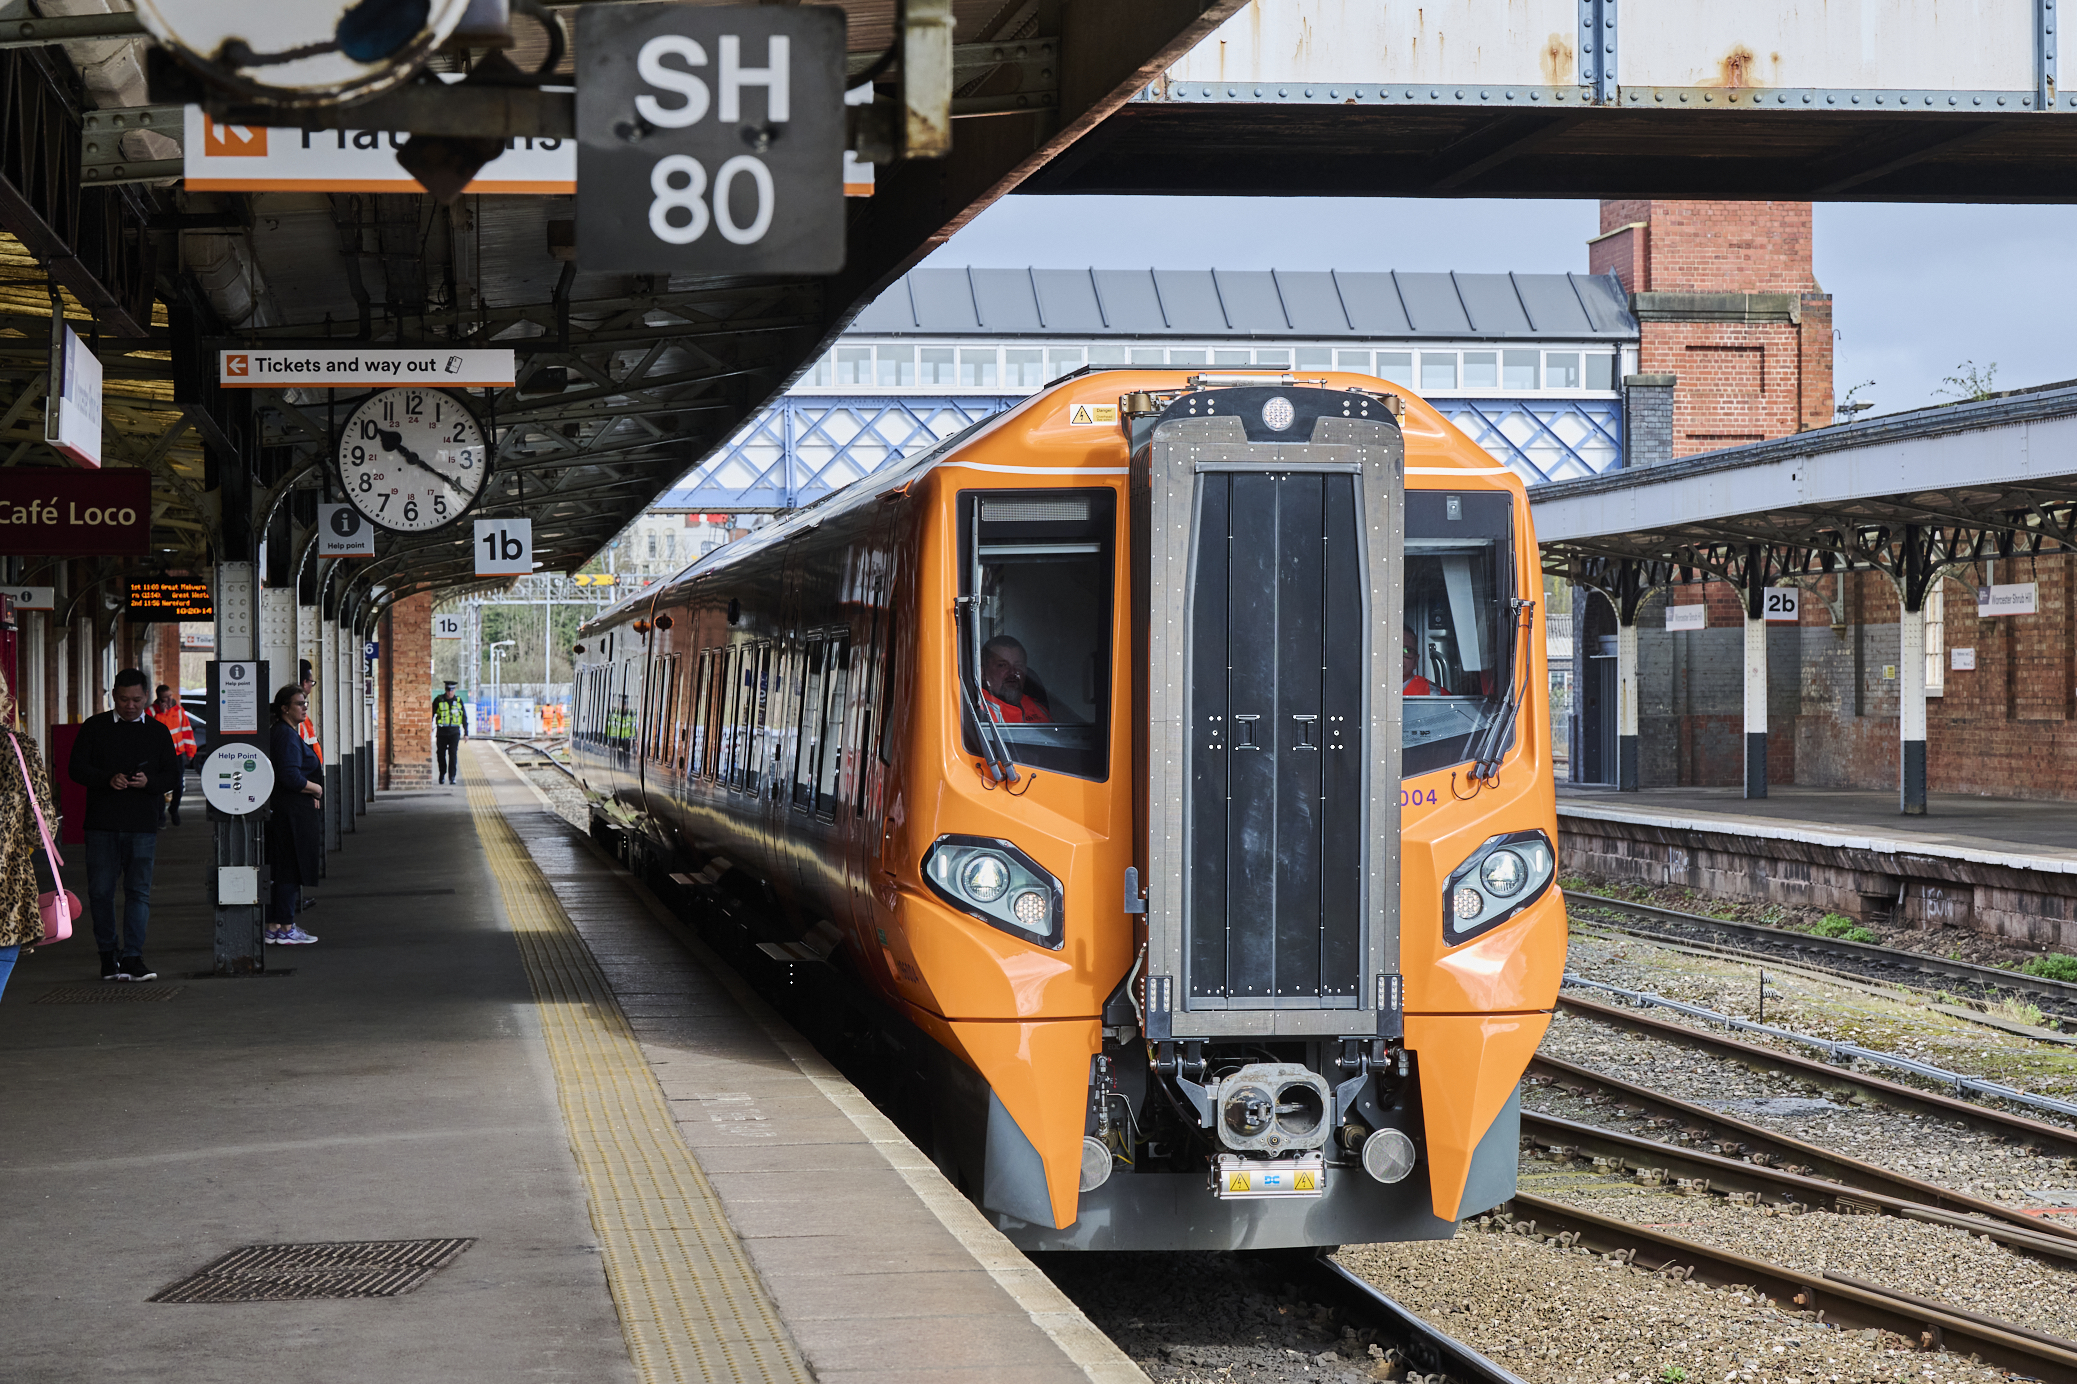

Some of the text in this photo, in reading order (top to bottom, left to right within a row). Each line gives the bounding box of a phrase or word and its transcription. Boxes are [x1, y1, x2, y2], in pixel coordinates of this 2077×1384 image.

[635, 34, 790, 128] SH
[649, 154, 775, 245] 80
[255, 356, 436, 376] Tickets and way out
[405, 395, 423, 415] 12
[360, 419, 378, 441] 10
[452, 422, 466, 443] 2
[351, 445, 365, 467] 9
[459, 450, 473, 470] 3
[358, 472, 372, 493] 8
[373, 473, 384, 481] 20
[0, 497, 137, 526] Café Loco
[377, 493, 390, 513] 7
[403, 501, 418, 522] 6
[433, 495, 447, 515] 5
[327, 542, 365, 550] Help point
[482, 529, 523, 561] 1b
[1768, 593, 1795, 613] 2b
[440, 618, 458, 632] 1b
[218, 752, 257, 760] Help Point
